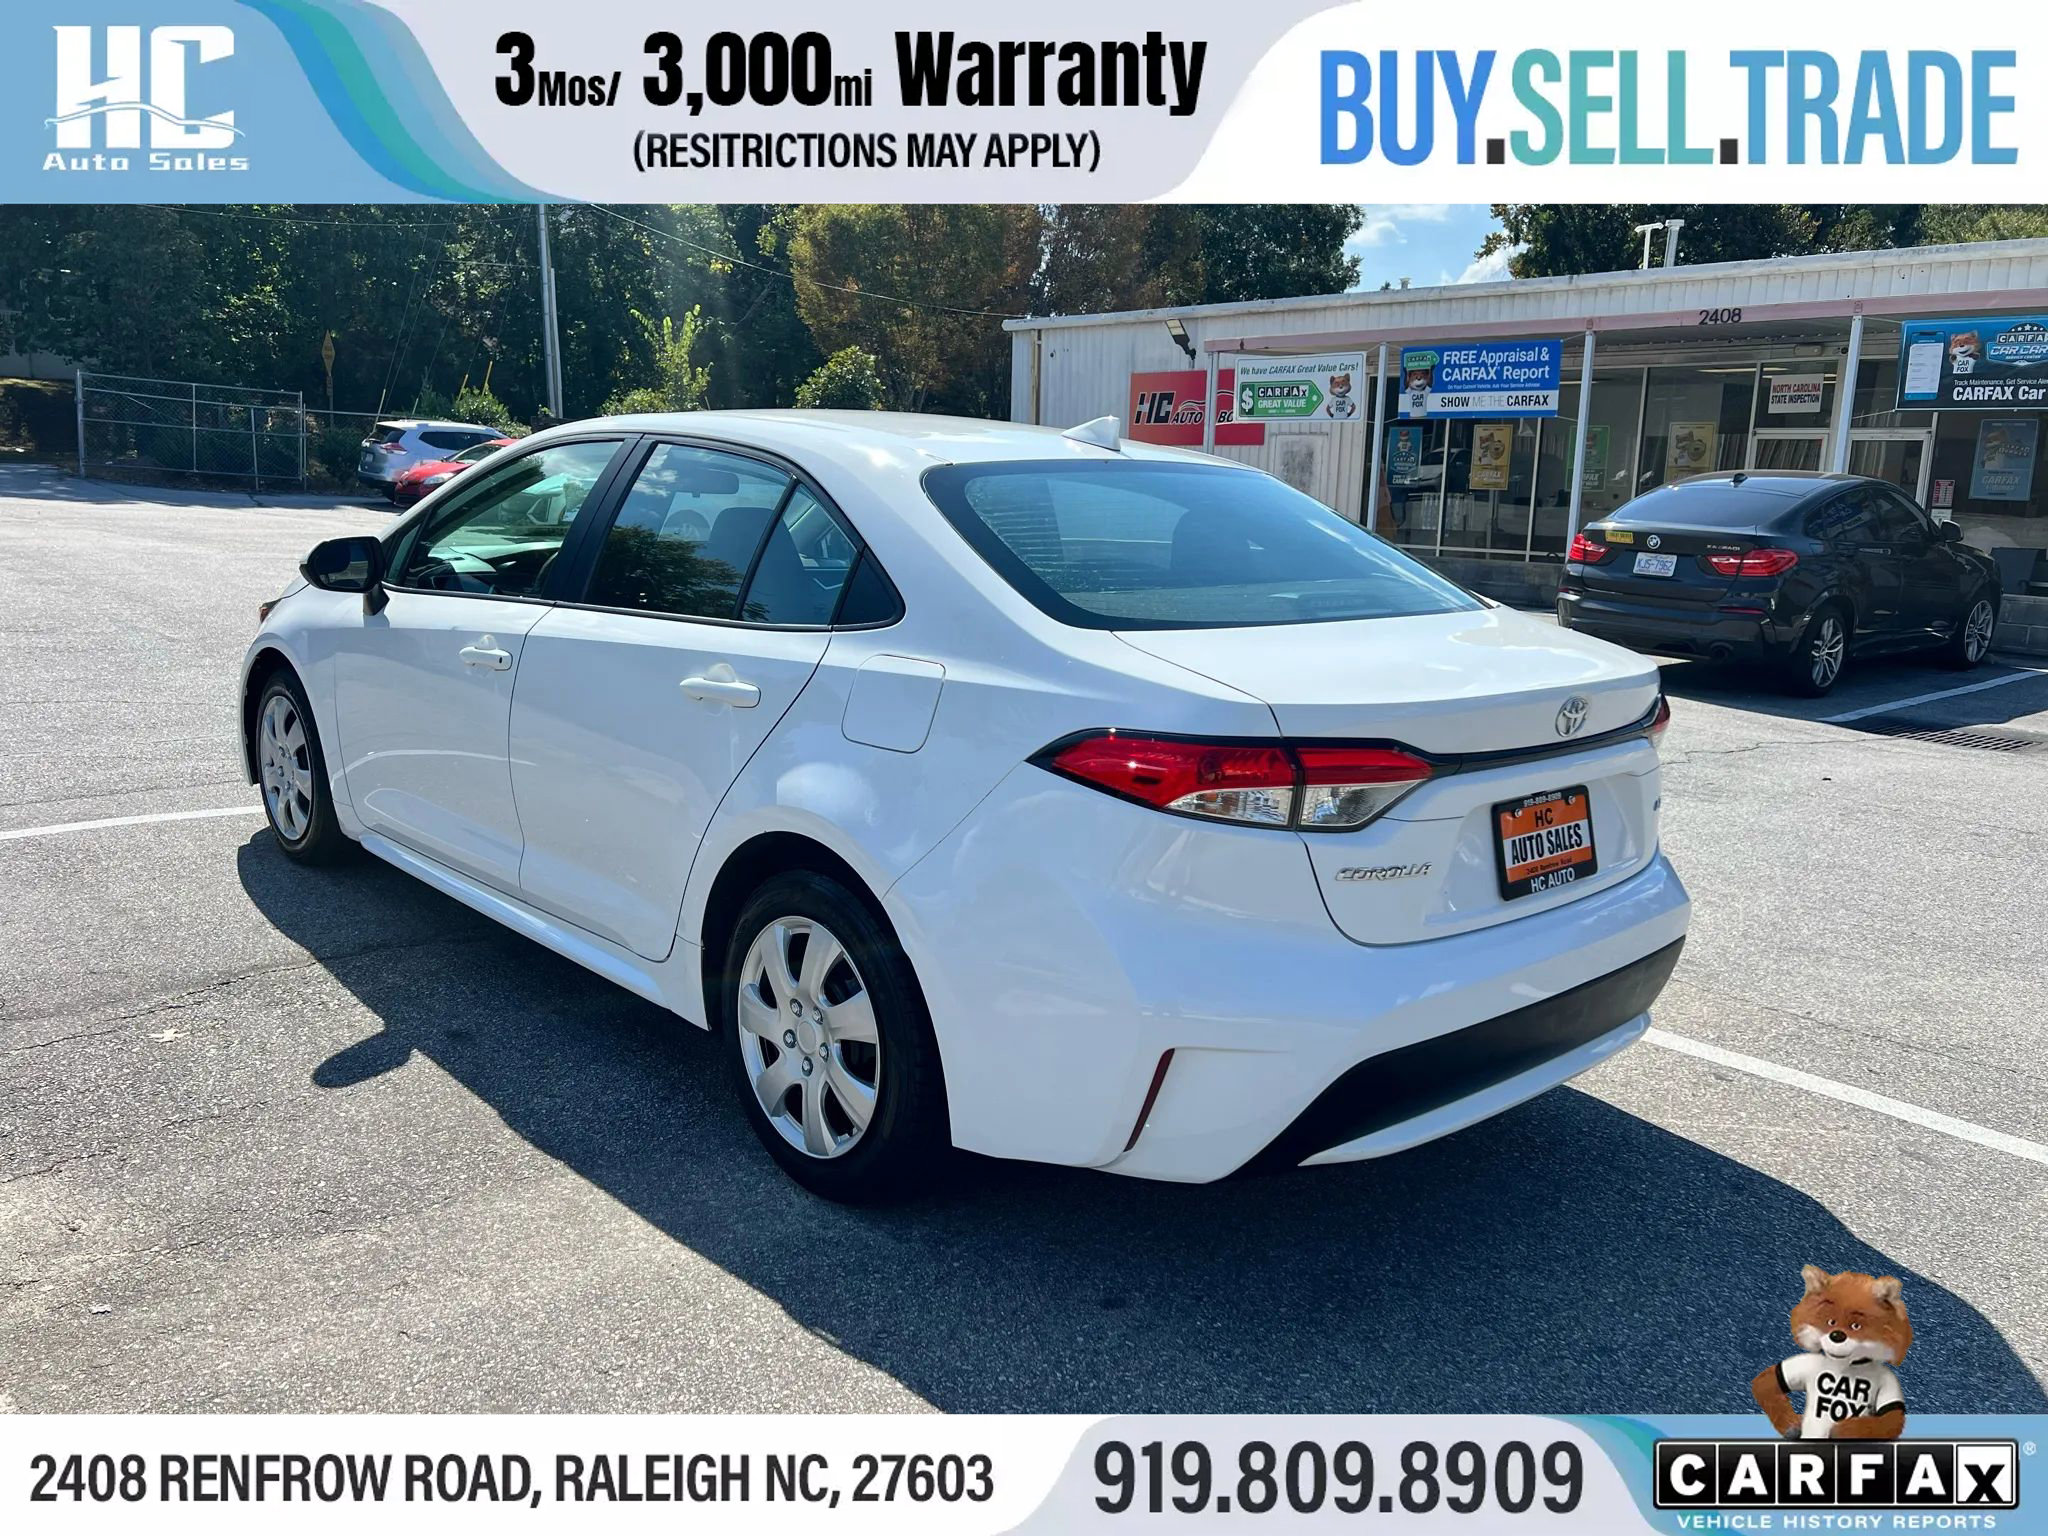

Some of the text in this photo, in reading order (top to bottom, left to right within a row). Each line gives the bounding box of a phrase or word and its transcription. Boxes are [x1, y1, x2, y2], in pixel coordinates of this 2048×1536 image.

[1698, 308, 1742, 326] 2408
[1443, 350, 1477, 365] FREE
[1478, 347, 1538, 366] Appraisal
[1540, 346, 1550, 362] &
[1990, 345, 2018, 355] CAR
[1240, 362, 1359, 375] We have CARFAX Great Value Cars!
[1957, 359, 1970, 367] CAR
[1442, 366, 1550, 382] CARFAX Report
[1258, 385, 1309, 398] CARFAX
[1772, 382, 1821, 394] NORTH CAROLINA
[1952, 385, 2047, 401] CARFAX Car
[1258, 398, 1307, 409] GREAT VALUE
[1411, 393, 1424, 401] CAR
[1440, 394, 1549, 408] SHOW ME THE CARFAX
[1770, 393, 1820, 405] STATE INSPECTION
[1134, 391, 1177, 425] HC
[1170, 410, 1206, 426] AUTO
[1534, 807, 1554, 828] HC
[1511, 823, 1583, 865] AUTO SALES
[1335, 861, 1433, 882] COROLLA
[1530, 867, 1576, 893] HC AUTO
